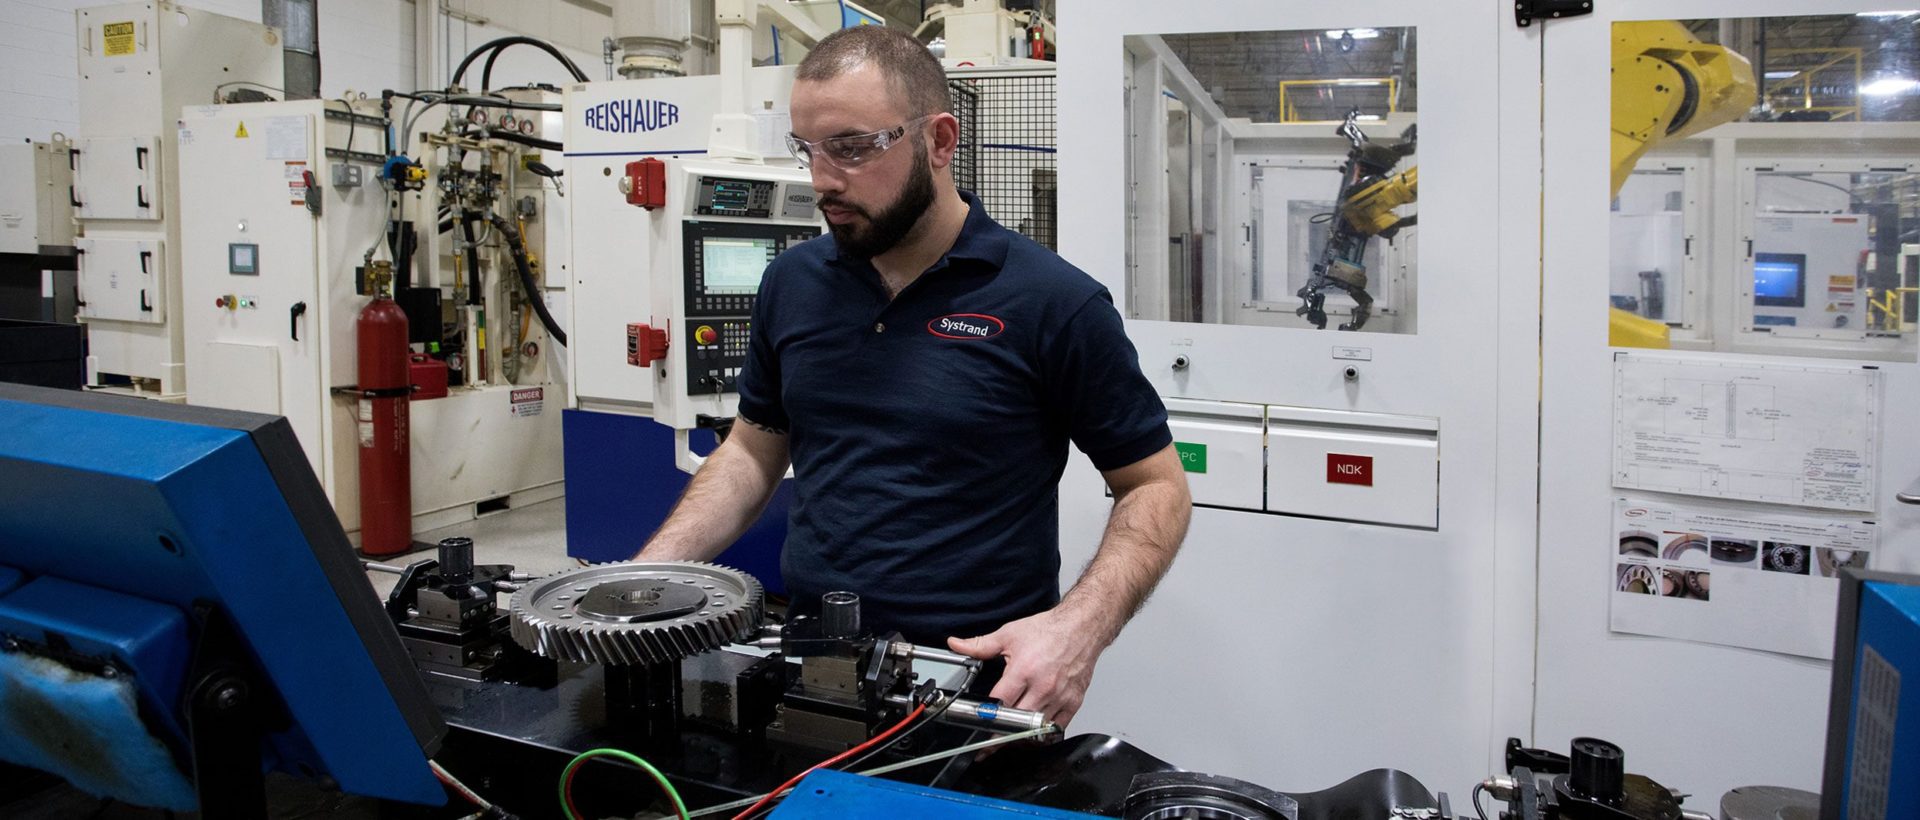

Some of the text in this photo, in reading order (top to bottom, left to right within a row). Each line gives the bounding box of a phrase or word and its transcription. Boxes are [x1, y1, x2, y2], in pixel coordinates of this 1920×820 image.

[585, 99, 678, 133] REISHAUER
[940, 317, 989, 337] Systrand
[513, 390, 540, 401] DANGER
[1179, 451, 1197, 462] PC
[1337, 463, 1363, 475] NOK
